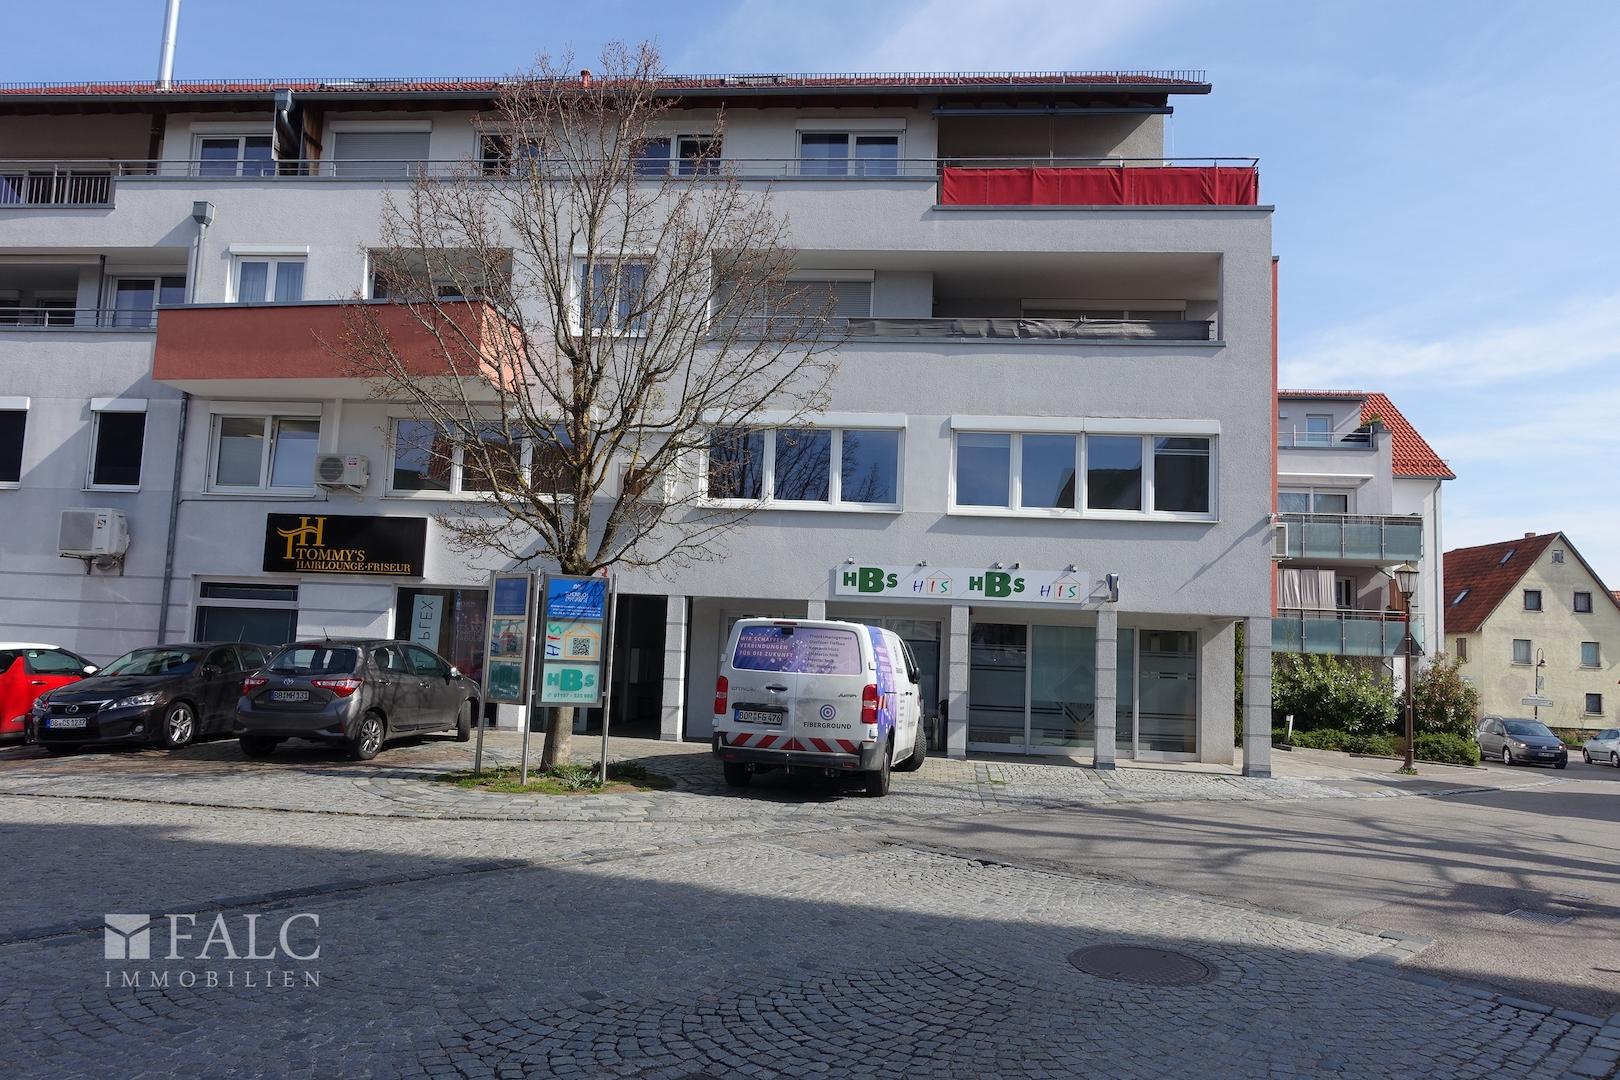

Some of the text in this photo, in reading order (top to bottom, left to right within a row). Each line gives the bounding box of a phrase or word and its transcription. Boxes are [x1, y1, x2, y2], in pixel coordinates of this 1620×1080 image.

[296, 548, 365, 561] TOMMY'S
[843, 567, 1077, 598] HBS HIS HBS HIS
[547, 669, 594, 691] HBS
[739, 711, 753, 721] BOR
[757, 712, 767, 721] FG
